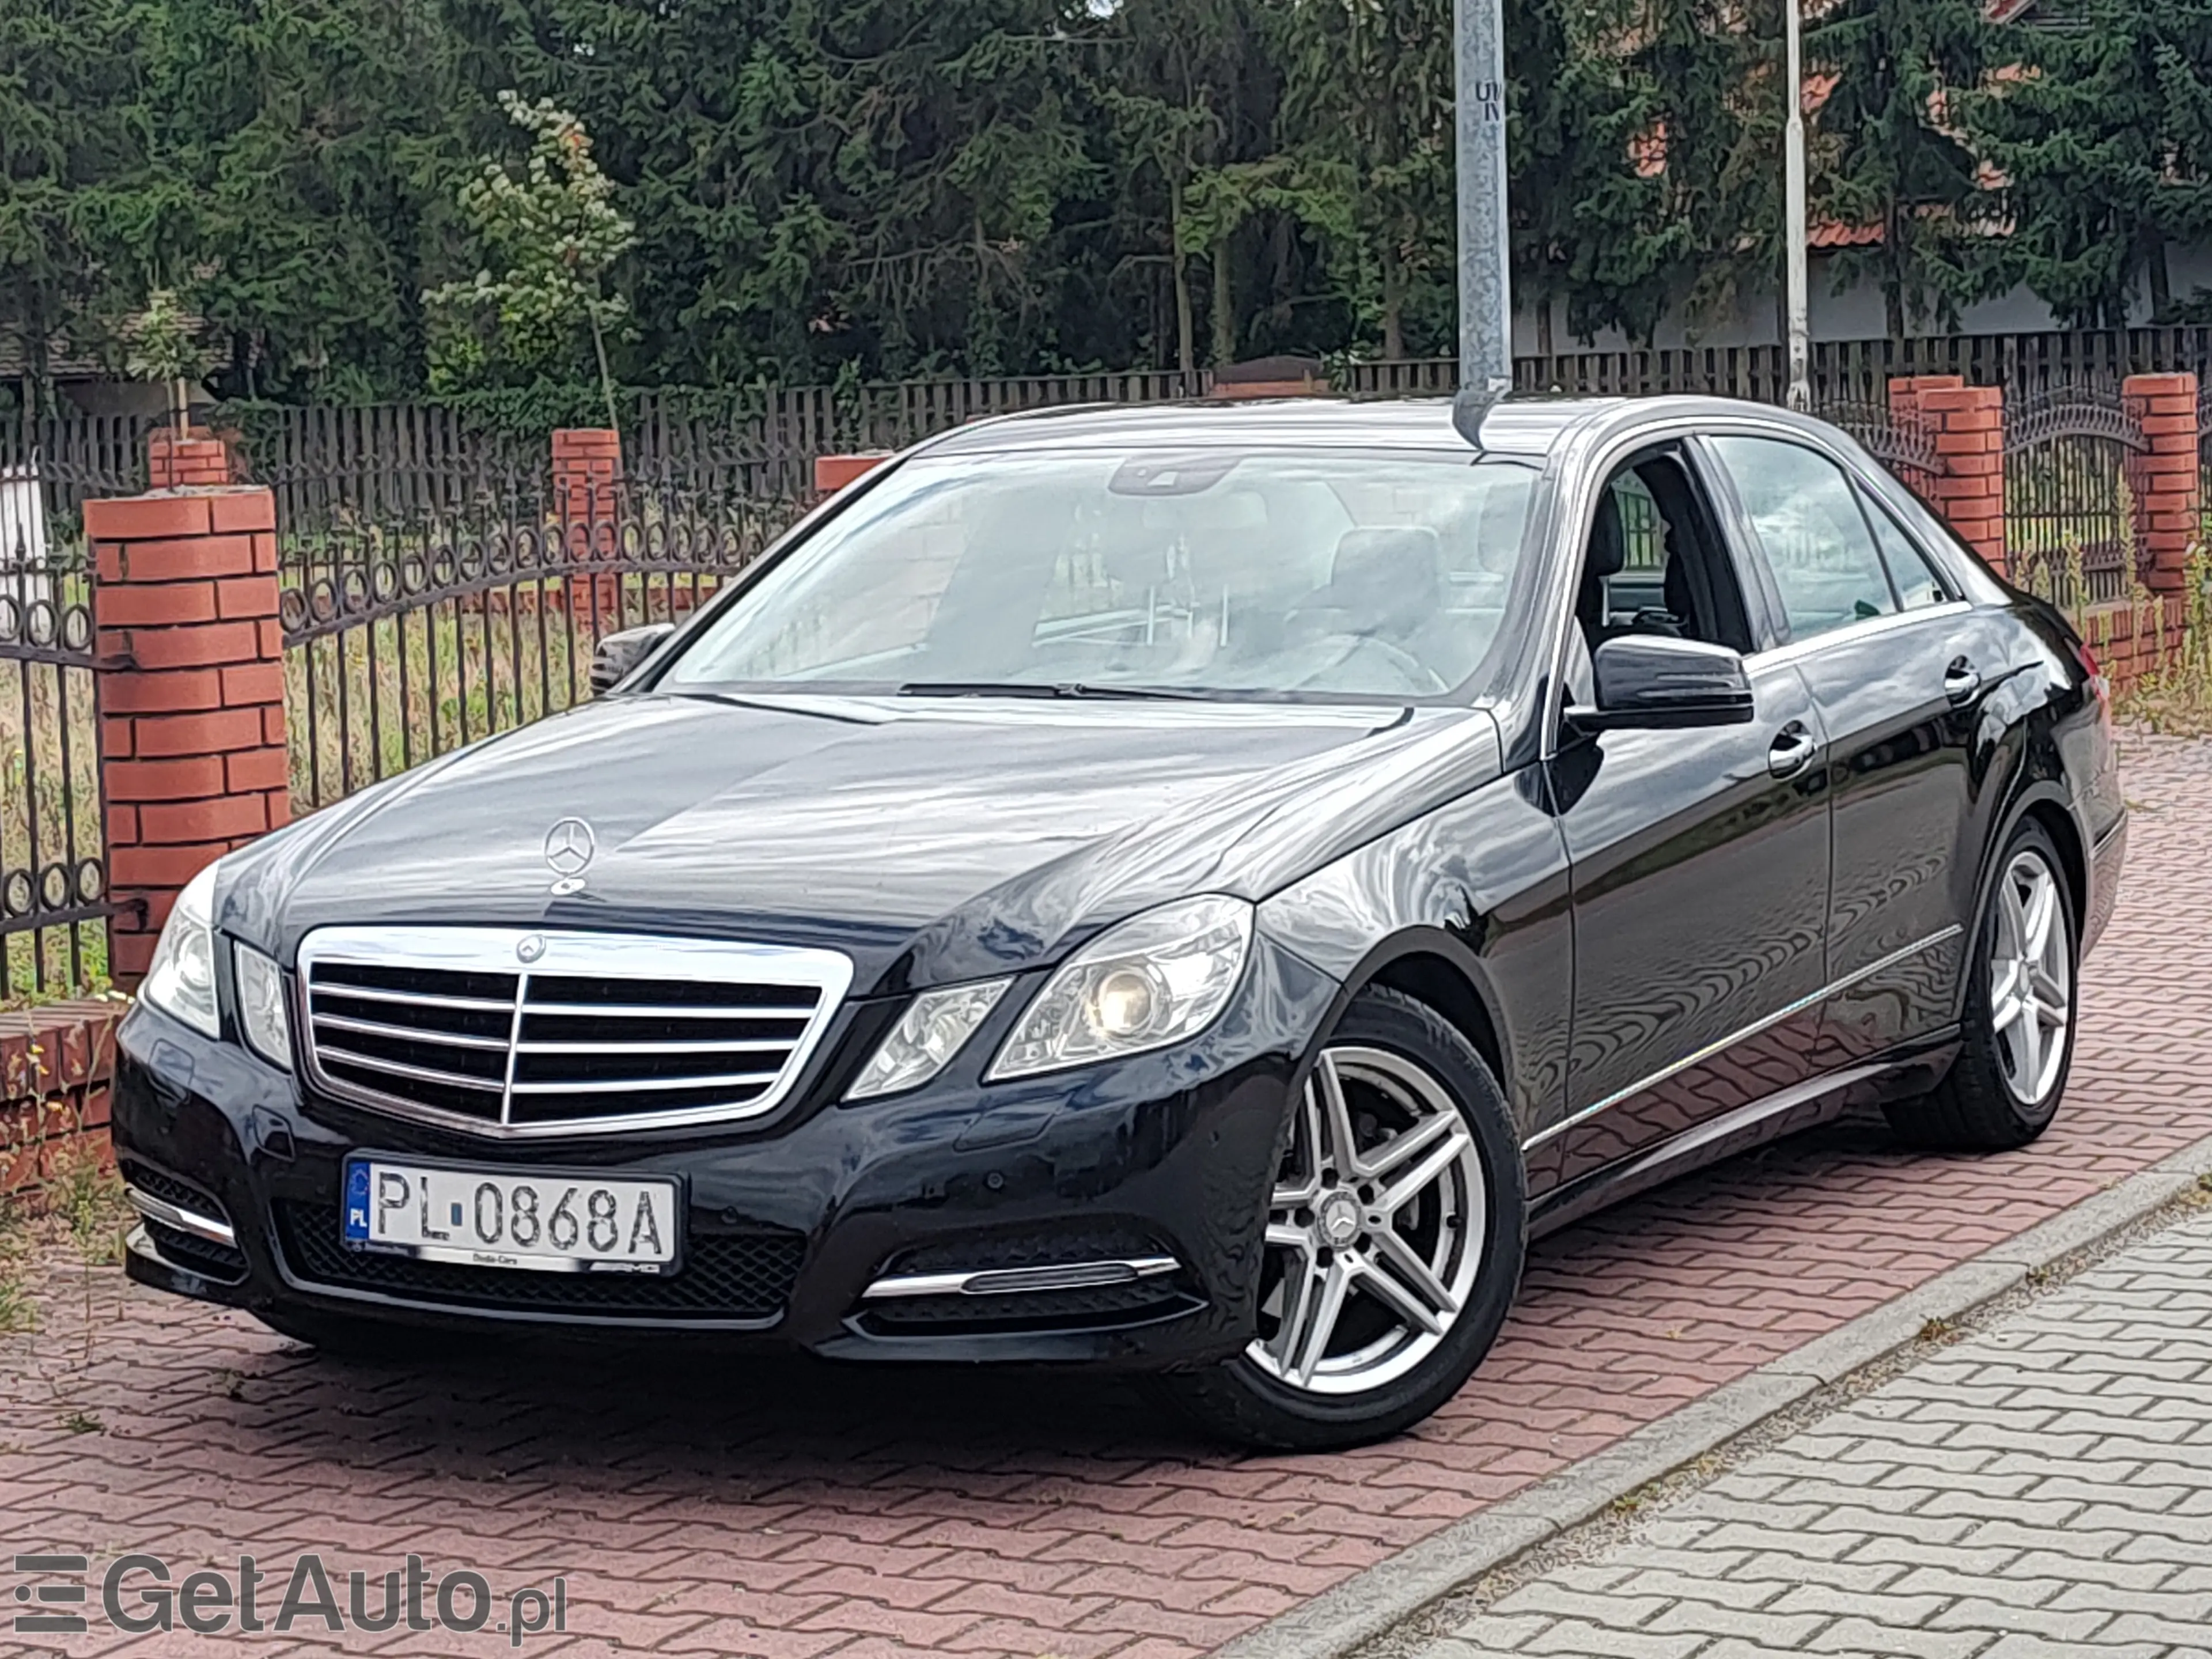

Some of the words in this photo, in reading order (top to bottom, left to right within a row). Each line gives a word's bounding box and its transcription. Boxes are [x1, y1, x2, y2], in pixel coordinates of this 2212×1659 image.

[350, 1208, 368, 1228] PL
[378, 1171, 450, 1241] PL
[474, 1181, 662, 1255] 0868A
